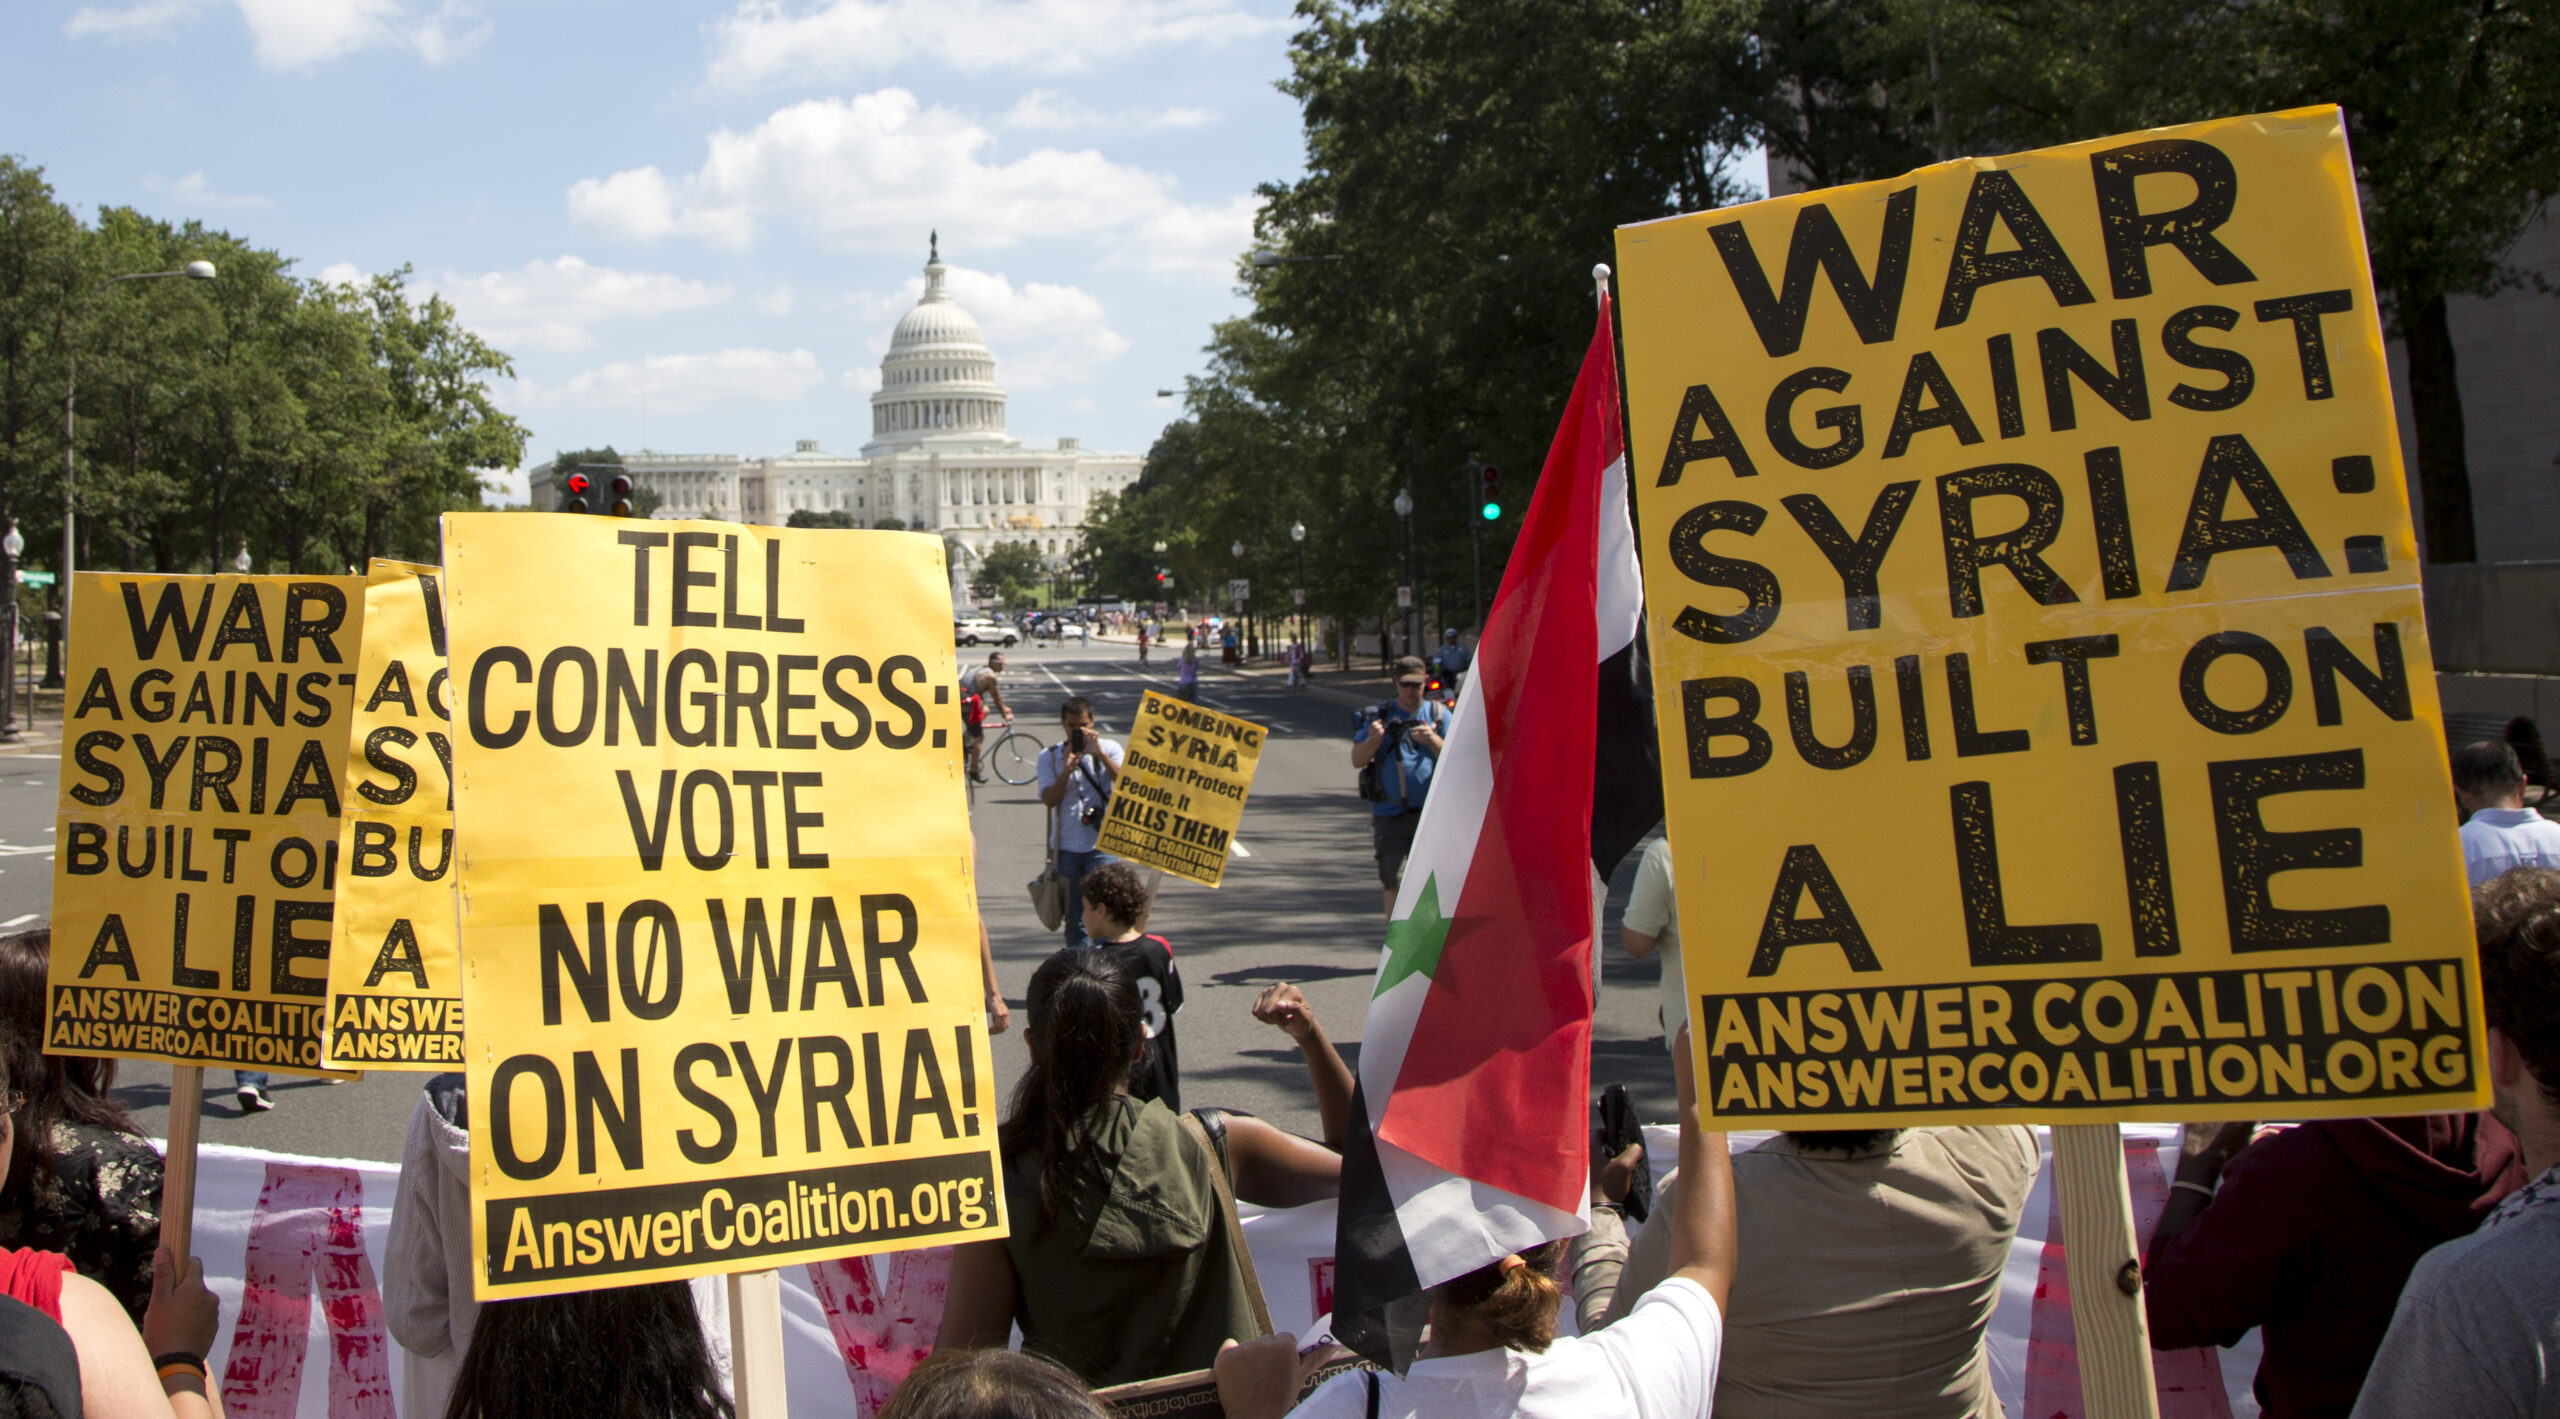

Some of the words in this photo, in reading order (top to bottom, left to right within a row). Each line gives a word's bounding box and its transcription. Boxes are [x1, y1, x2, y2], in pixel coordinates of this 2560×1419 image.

[1706, 138, 2260, 359] WAR
[1655, 289, 2354, 489] AGAINST
[617, 530, 806, 634] TELL
[1668, 433, 2391, 645] SYRIA:
[120, 582, 347, 664] WAR
[467, 645, 950, 750] CONGRESS:
[1145, 697, 1260, 749] BOMBING
[1680, 634, 2120, 780] BUILT
[2178, 621, 2415, 736] ON
[1119, 776, 1174, 808] People.
[1177, 794, 1191, 812] It
[1127, 750, 1186, 783] Doesn't
[1187, 769, 1245, 801] Protect
[1146, 725, 1239, 773] SYRIA
[66, 822, 252, 884] BUILT
[615, 769, 830, 872] VOTE
[1106, 821, 1157, 848] ANSWER
[1159, 835, 1222, 870] COALITION
[1111, 796, 1169, 832] KILLS
[1171, 814, 1230, 851] THEM
[1746, 843, 1884, 979] A
[1948, 748, 2392, 969] LIE
[77, 914, 141, 981] A
[172, 892, 335, 997] LIE
[363, 918, 430, 989] A
[706, 892, 929, 1016] WAR
[54, 989, 181, 1025] ANSWER
[333, 1032, 465, 1061] ANSWER
[1711, 984, 2017, 1060] ANSWER
[2032, 963, 2463, 1046] COALITION
[488, 1047, 645, 1182] ON
[673, 1025, 979, 1165] SYRIA!
[1716, 1034, 2467, 1111] ANSWERCOALITION.ORG
[503, 1175, 984, 1274] AnswerCoalition.org
